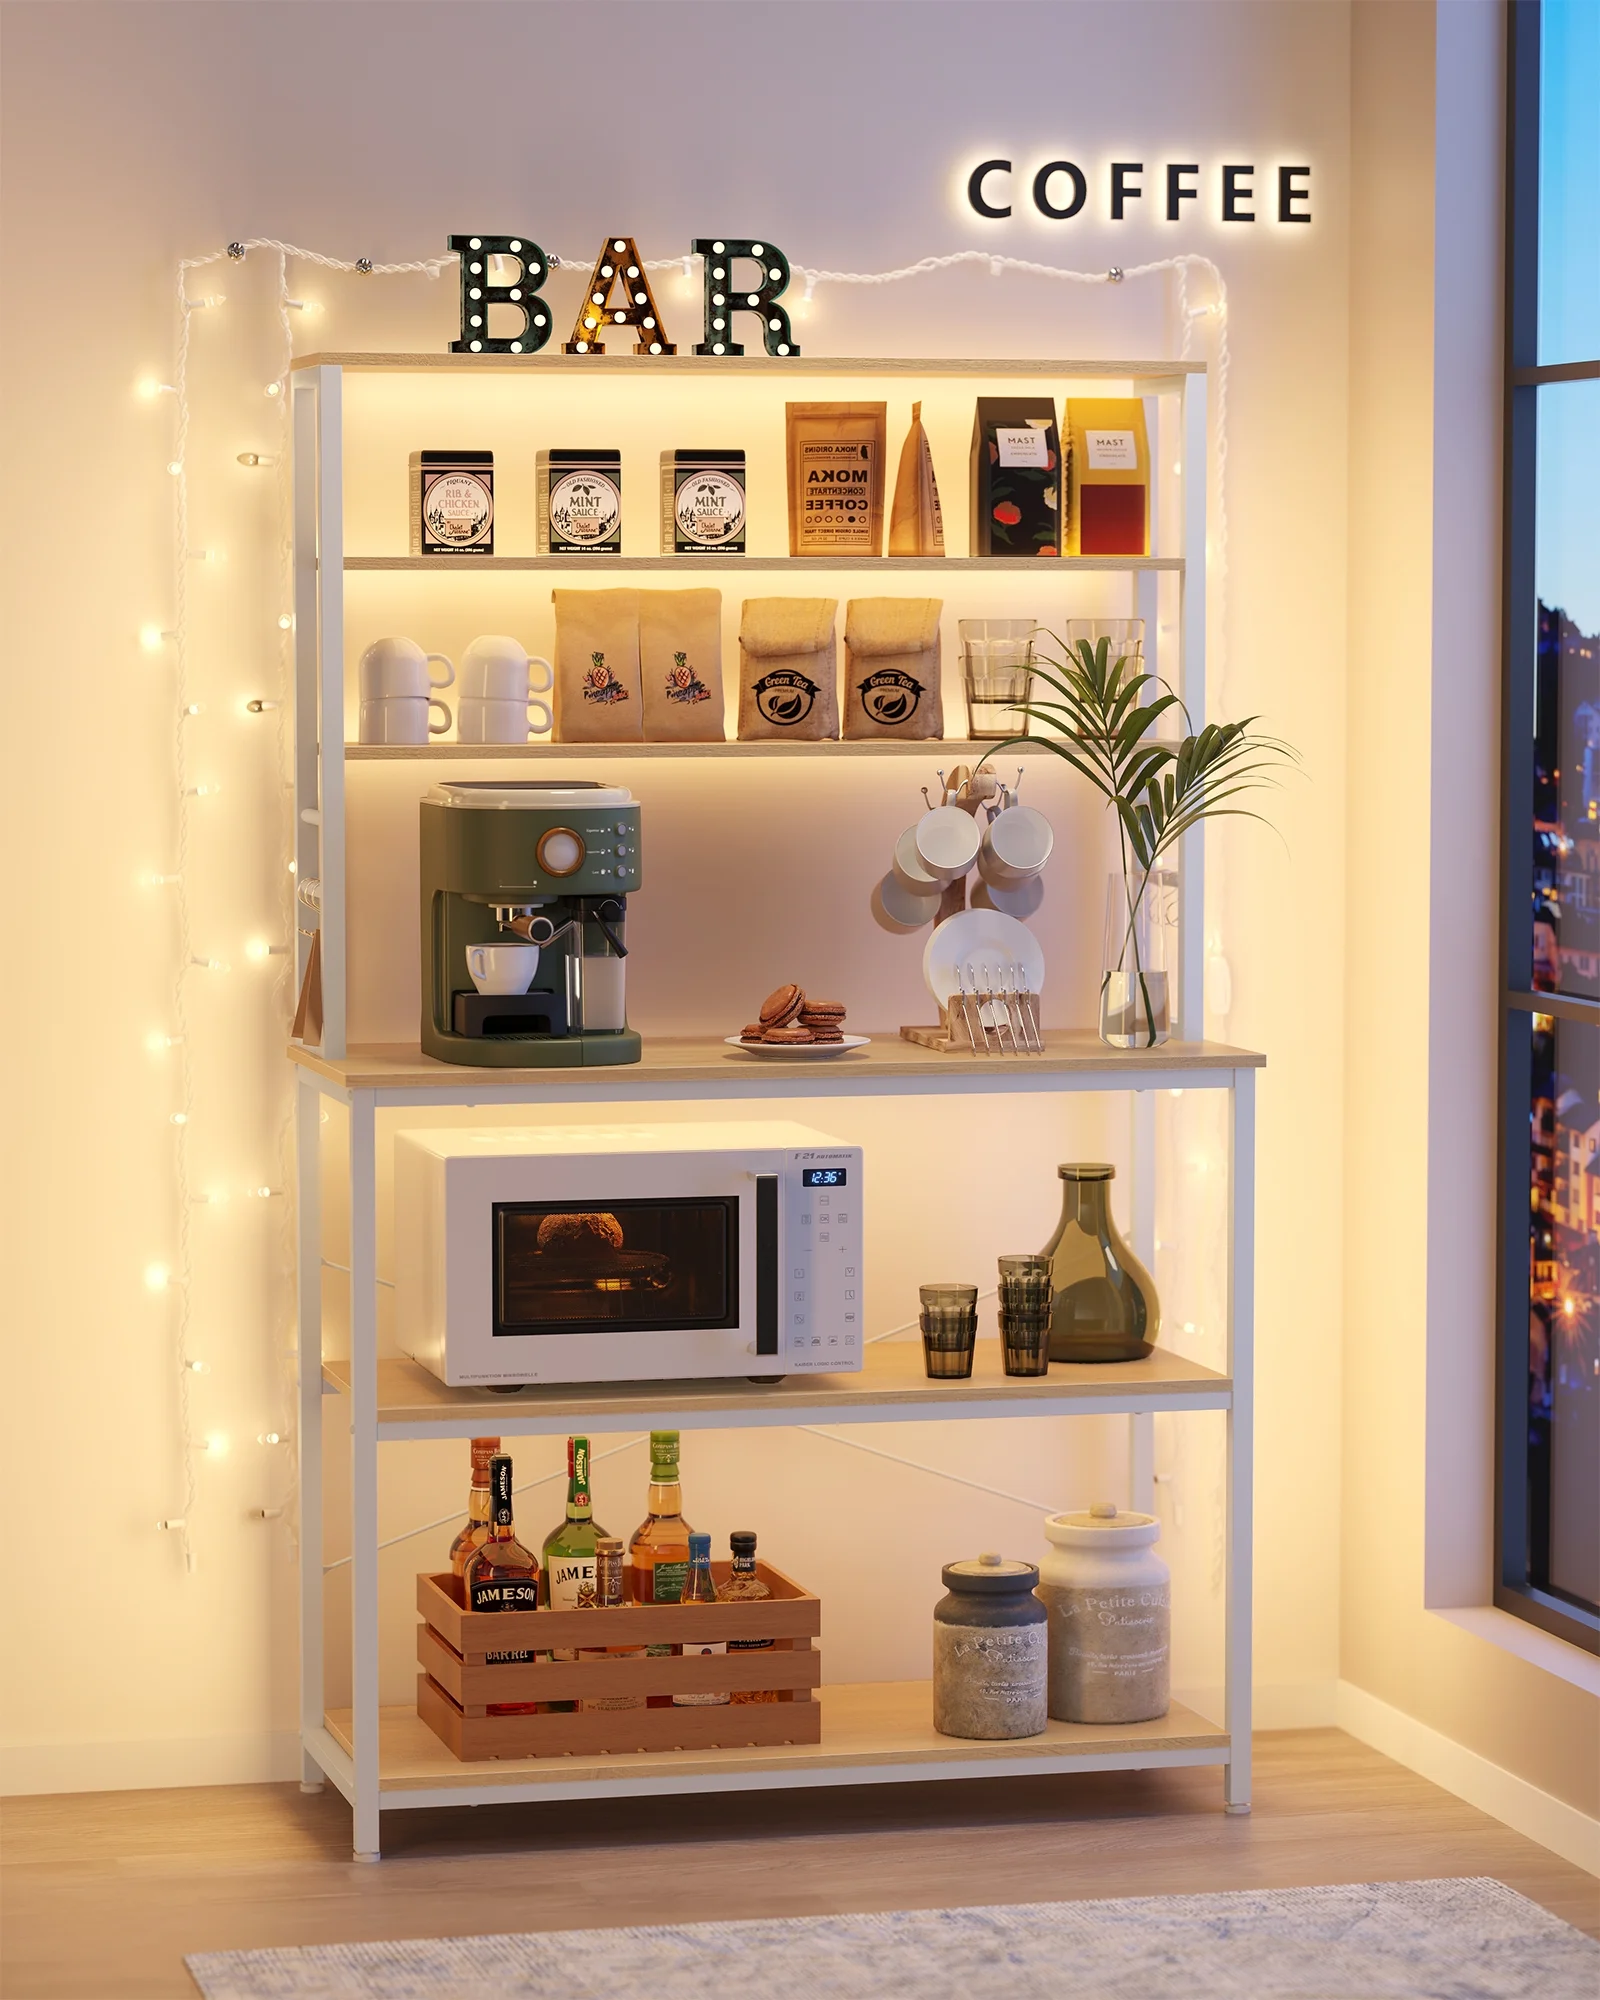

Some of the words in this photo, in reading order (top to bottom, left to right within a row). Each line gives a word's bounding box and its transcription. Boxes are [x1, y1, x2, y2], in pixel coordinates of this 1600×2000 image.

[968, 159, 1311, 223] COFFEE
[447, 234, 801, 357] BAR
[446, 478, 472, 486] PIQUANT
[445, 489, 462, 498] RIB
[464, 489, 472, 498] &
[438, 500, 480, 508] CHICKEN
[569, 496, 602, 507] MINT
[694, 496, 727, 507] MINT
[571, 508, 599, 516] SAUCE
[697, 508, 724, 516] SAUCE
[764, 676, 790, 688] Green
[792, 675, 809, 690] Tea
[869, 676, 895, 688] Green
[897, 675, 914, 690] Tea
[576, 1448, 586, 1485] JAMESON
[500, 1466, 508, 1500] JAMESON
[556, 1566, 597, 1584] JAME
[476, 1587, 535, 1604] JAMESON
[1058, 1604, 1081, 1617] La
[1085, 1595, 1135, 1611] Petite
[954, 1643, 970, 1657] La
[973, 1633, 1022, 1649] Petite
[487, 1650, 528, 1660] BARREL
